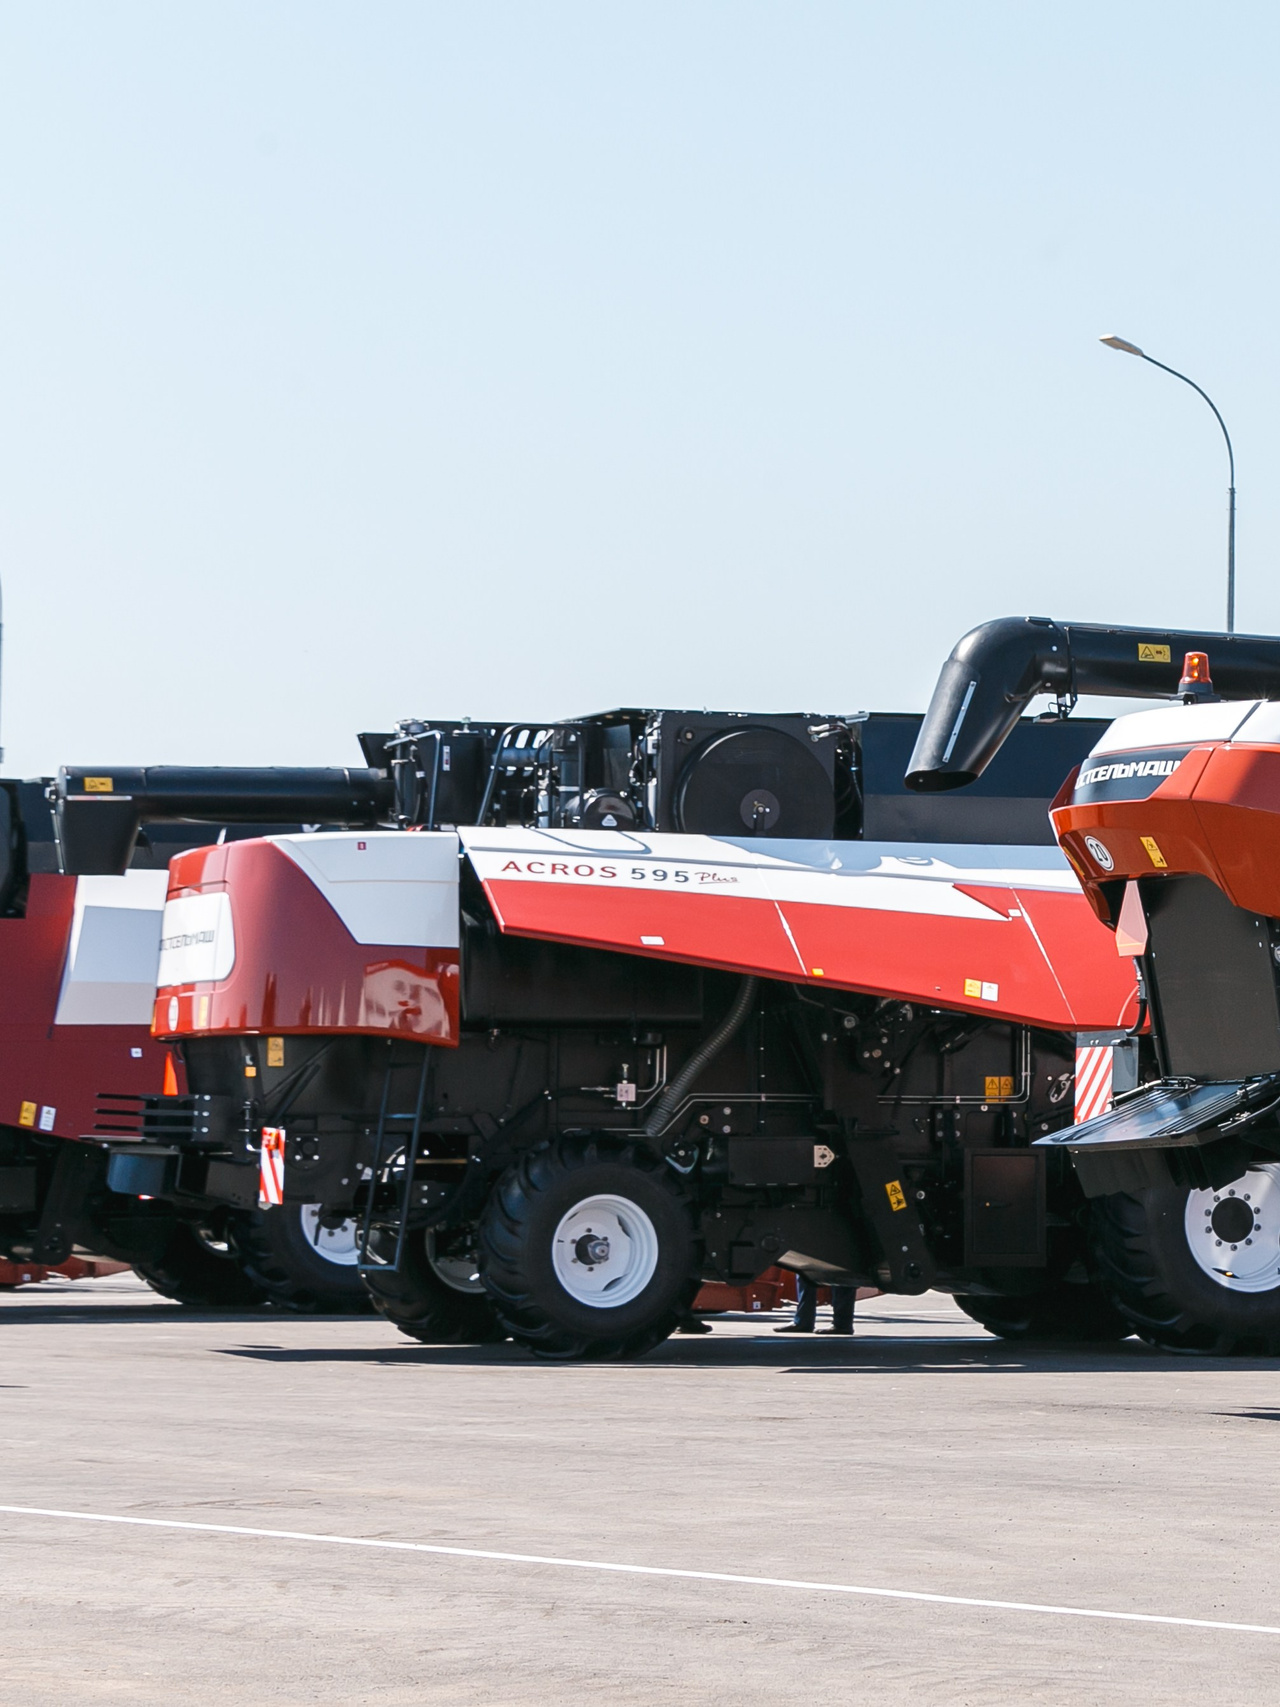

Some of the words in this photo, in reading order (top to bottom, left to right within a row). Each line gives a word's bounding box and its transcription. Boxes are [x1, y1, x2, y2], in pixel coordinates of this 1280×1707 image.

[1074, 760, 1182, 790] ОСТСЕЛЬМАШ
[1089, 842, 1109, 862] 20
[501, 860, 618, 879] ACROS
[630, 867, 690, 883] 595
[694, 871, 741, 884] Plus
